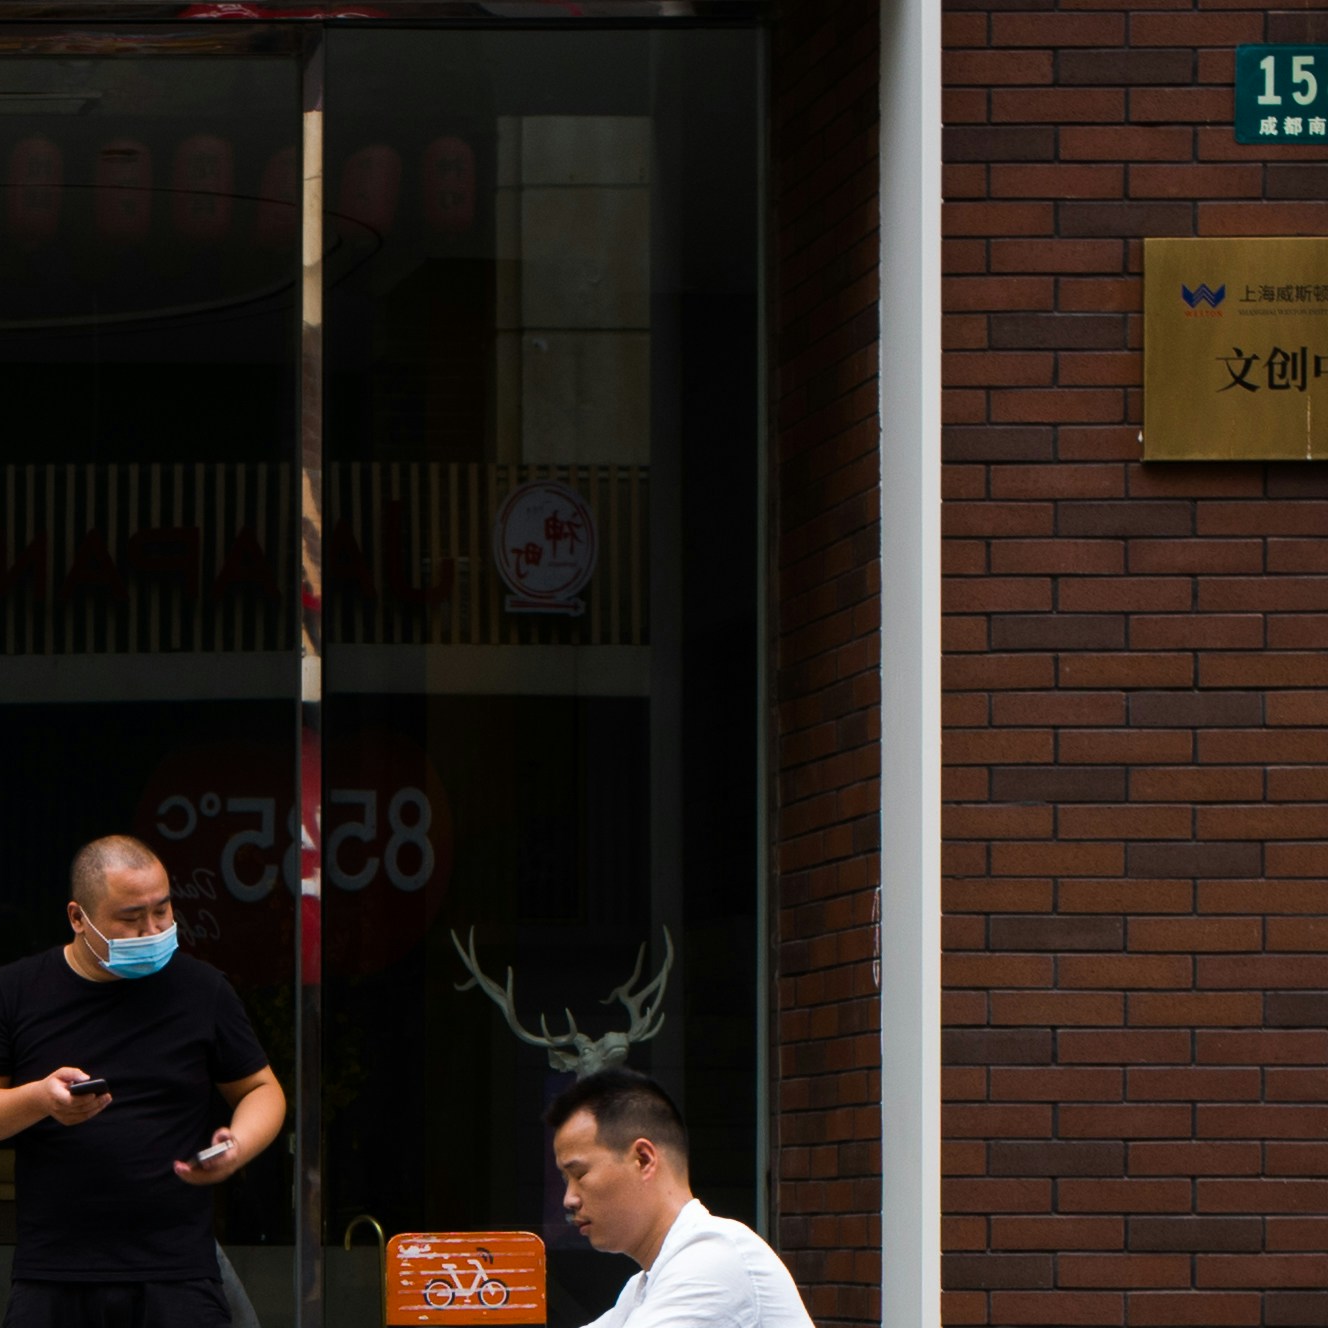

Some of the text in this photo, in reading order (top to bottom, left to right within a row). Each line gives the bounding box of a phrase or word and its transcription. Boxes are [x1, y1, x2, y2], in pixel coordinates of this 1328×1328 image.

[1257, 55, 1328, 106] 15
[1259, 116, 1327, 136] 成都南
